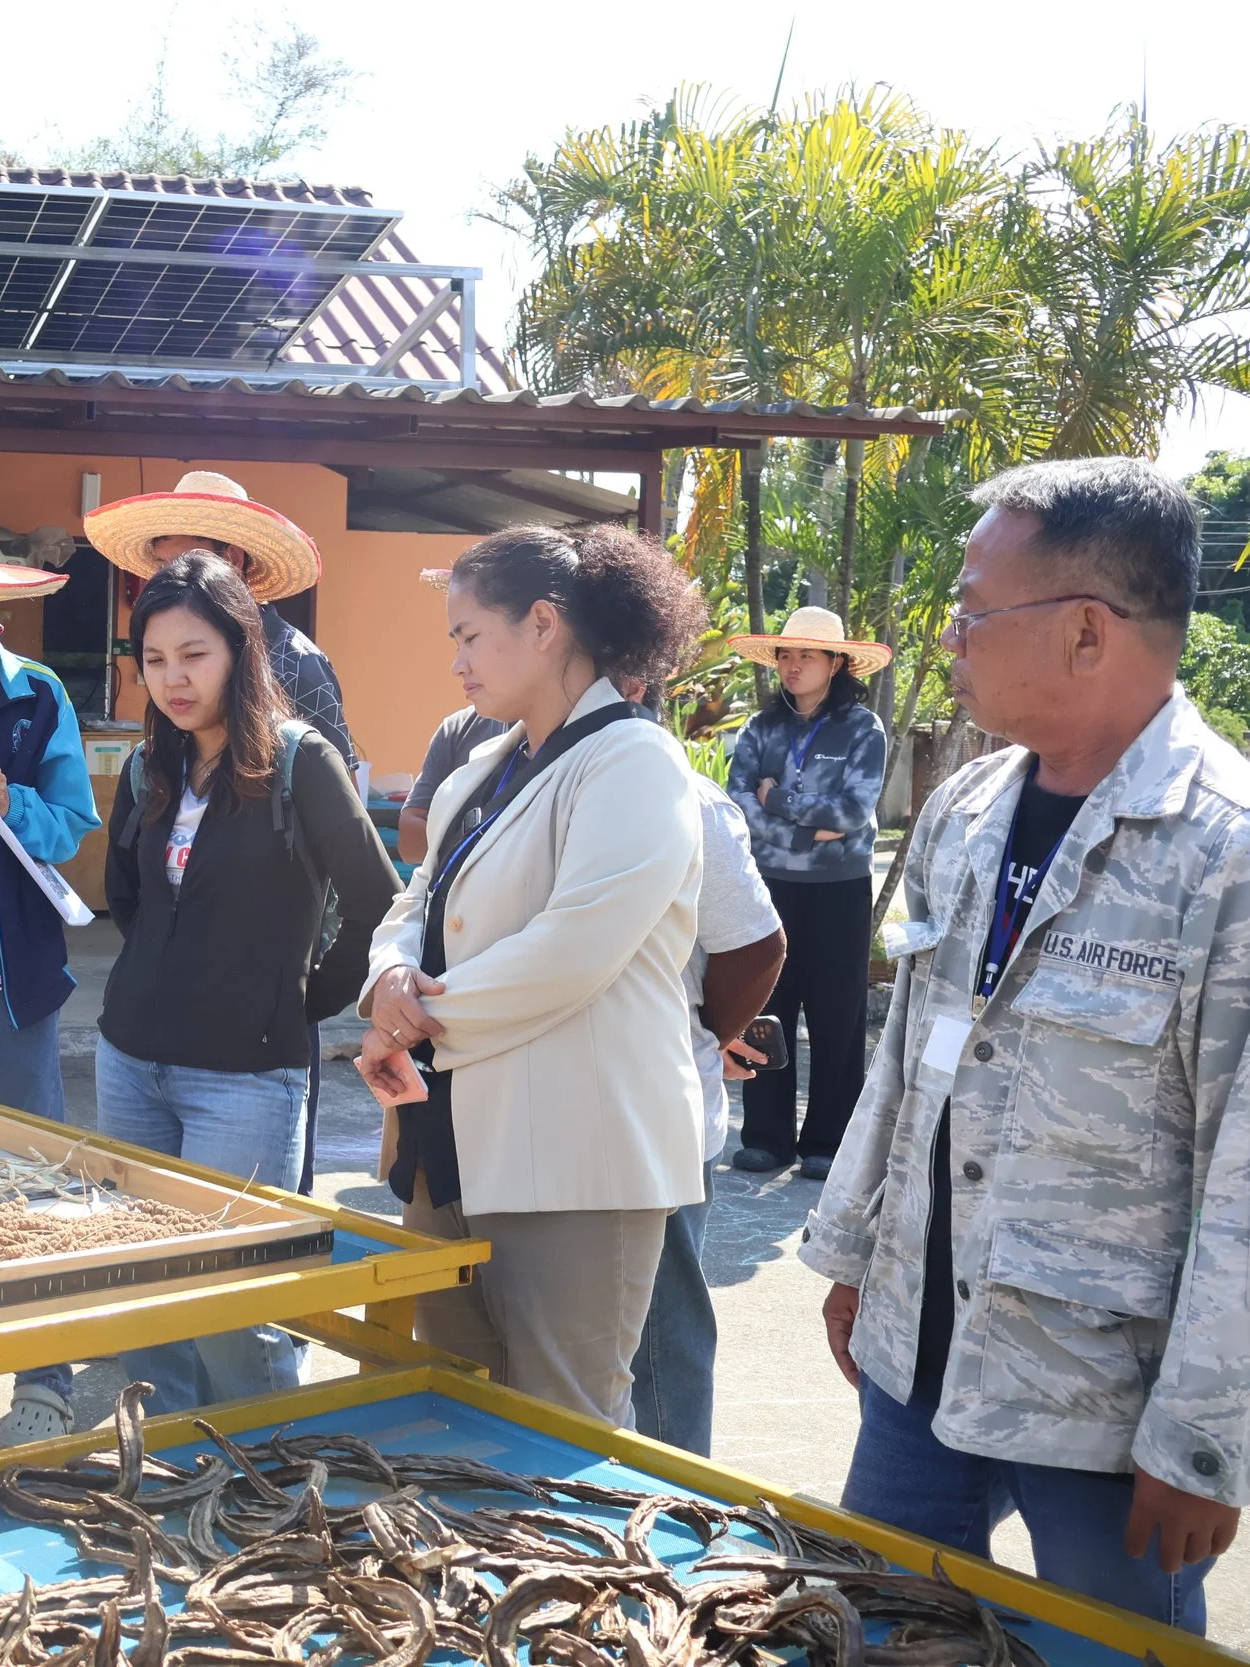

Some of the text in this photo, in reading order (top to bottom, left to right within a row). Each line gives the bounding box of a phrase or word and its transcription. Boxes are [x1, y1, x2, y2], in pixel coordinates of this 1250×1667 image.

[1044, 933, 1177, 982] U.S. AIR FORCE
